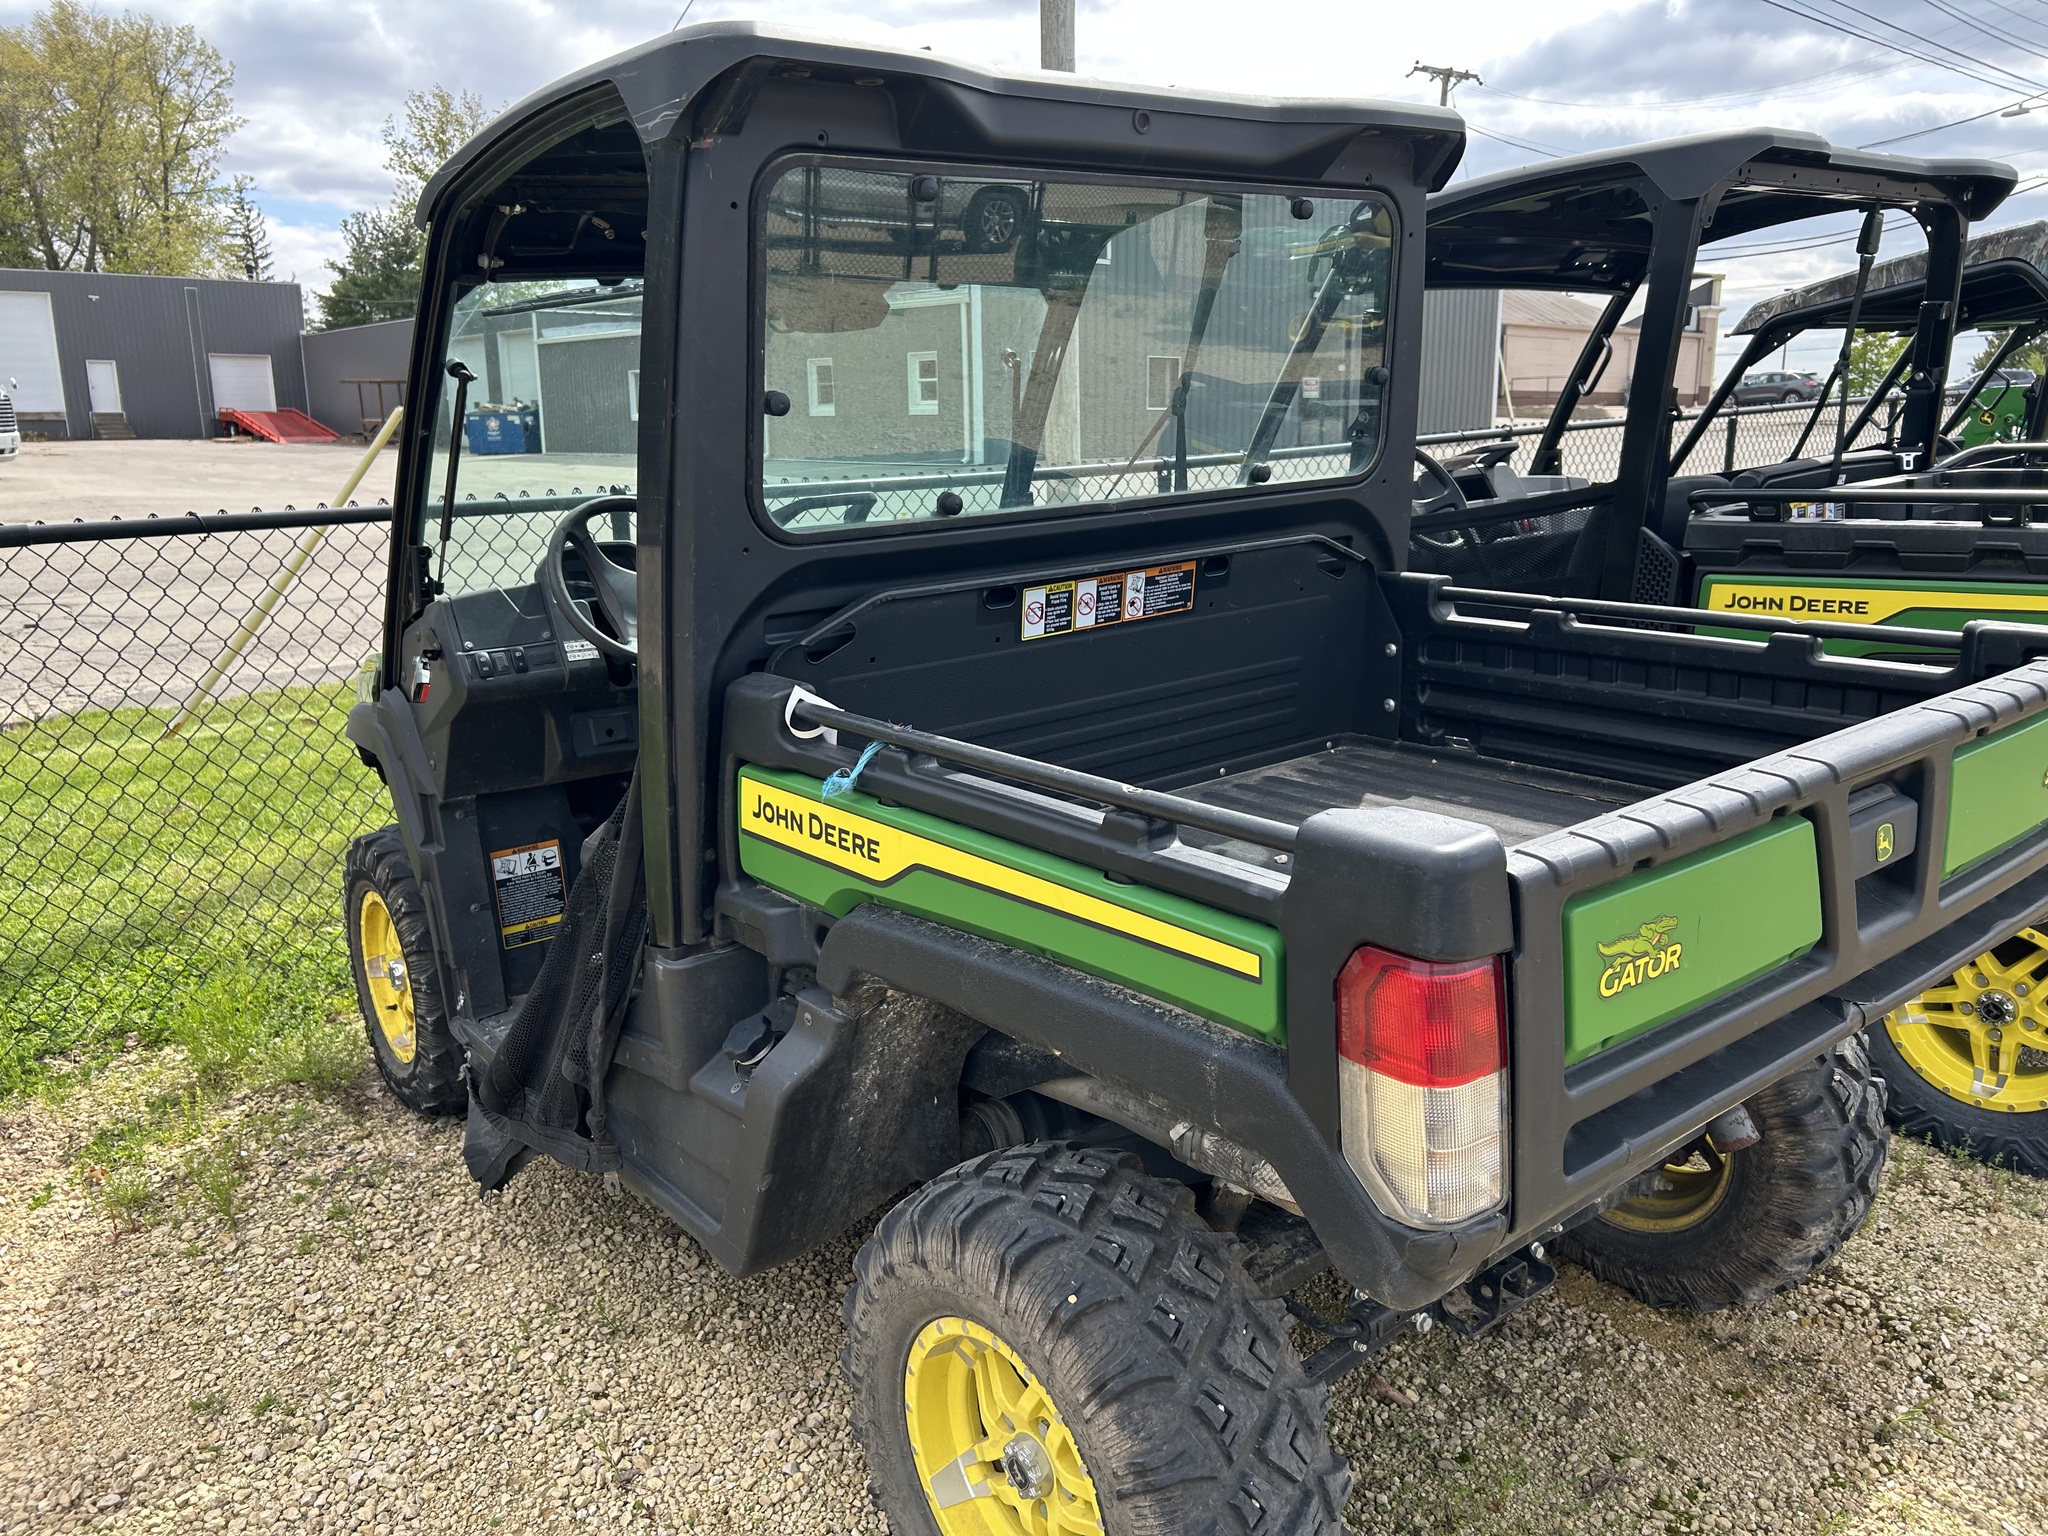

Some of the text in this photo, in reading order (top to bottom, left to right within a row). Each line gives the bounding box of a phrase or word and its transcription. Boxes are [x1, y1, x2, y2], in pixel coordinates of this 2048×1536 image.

[1053, 583, 1073, 591] CAUTION
[1724, 593, 1869, 615] JOHN DEERE
[752, 794, 881, 864] JOHN DEERE
[1598, 943, 1682, 998] GATOR
